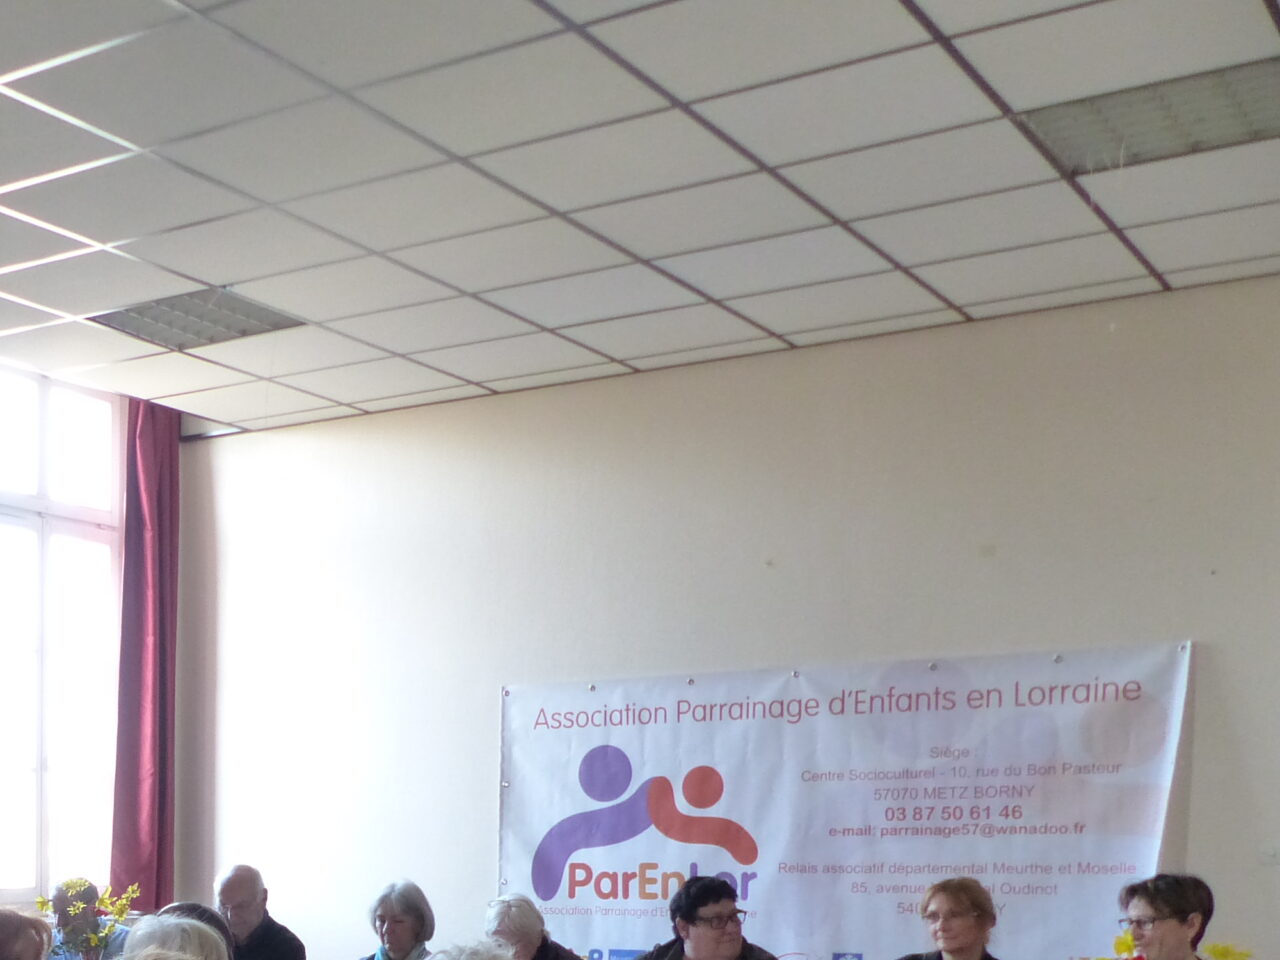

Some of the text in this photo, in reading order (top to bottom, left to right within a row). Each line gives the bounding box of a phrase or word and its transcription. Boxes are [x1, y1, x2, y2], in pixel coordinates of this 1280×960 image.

[533, 676, 1142, 730] Association Parrainage d'Enfants en Lorraine
[928, 746, 970, 761] Siège
[800, 770, 845, 783] Centre
[848, 766, 936, 782] Socioculturel
[975, 767, 1000, 778] rue
[1004, 763, 1022, 777] du
[1027, 763, 1057, 777] Bon
[1062, 761, 1123, 776] Pasteur
[873, 784, 1035, 801] 57070 METZ BORNY
[884, 804, 1024, 822] 03 87 50 61 46
[880, 821, 1087, 840] parrainage57@wanadoo.fr
[778, 860, 1137, 877] Relais associatif départemental Meurthe et Moselle
[850, 881, 872, 896] 85,
[875, 884, 924, 895] avenue
[999, 881, 1059, 896] Oudinot
[596, 905, 649, 919] Parrainage
